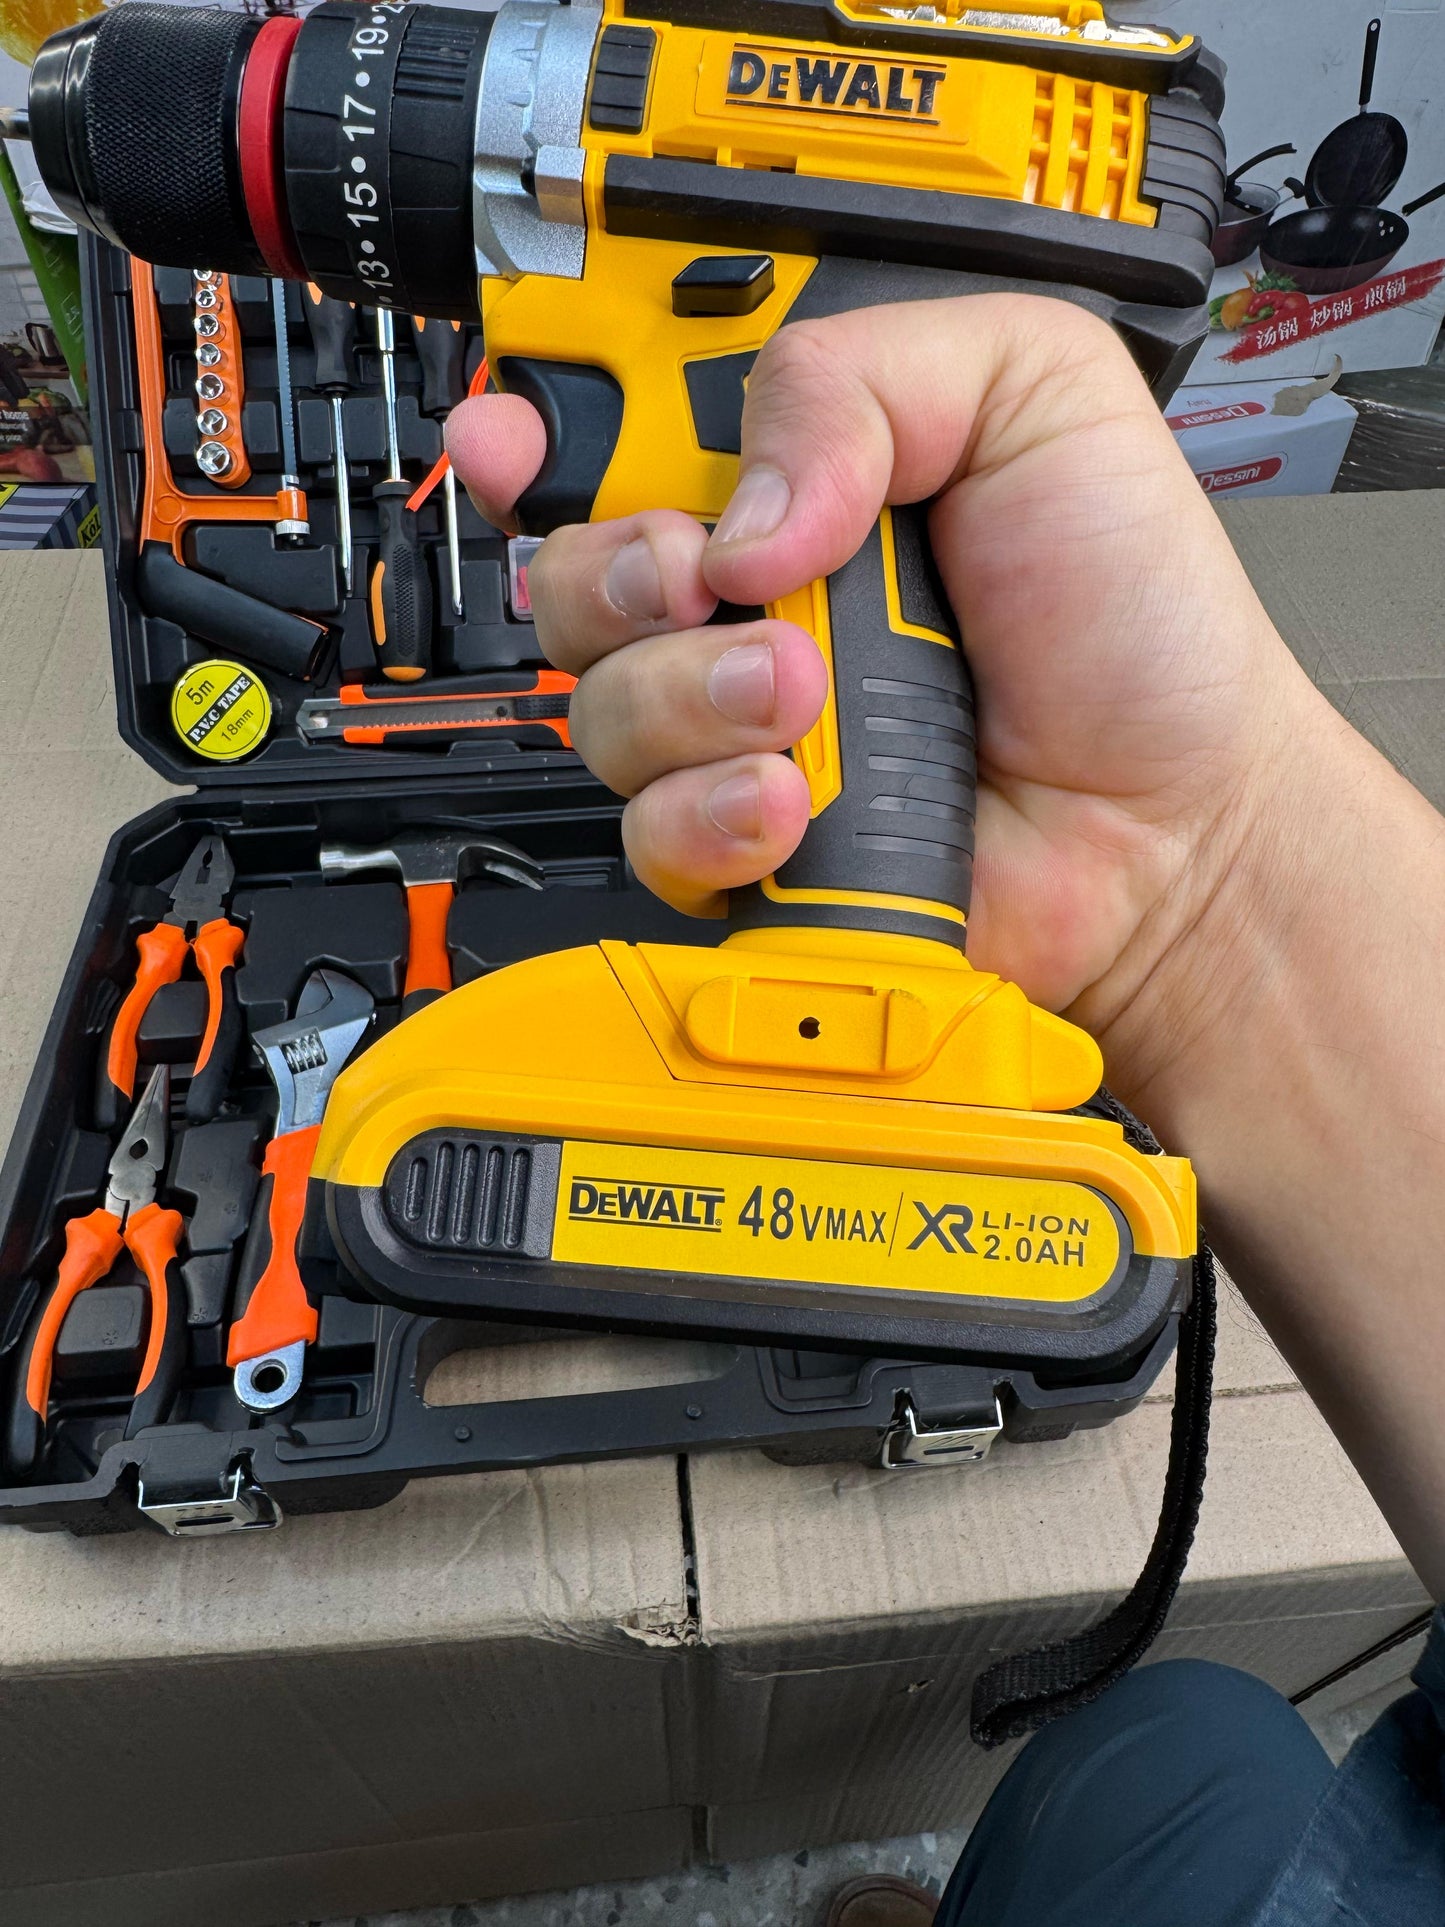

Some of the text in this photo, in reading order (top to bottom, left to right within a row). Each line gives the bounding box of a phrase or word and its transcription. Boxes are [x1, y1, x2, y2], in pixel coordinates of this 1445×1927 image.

[342, 2, 406, 289] 13 15 17 19 2
[1256, 276, 1406, 350] 汤锅 炒锅 煎锅
[186, 679, 216, 706] 5m
[189, 676, 251, 742] P.V.C TAPE
[221, 708, 255, 742] 18mm
[906, 1200, 978, 1254] XR
[982, 1210, 1090, 1237] LI-ION
[983, 1234, 1085, 1268] 2.0AH
